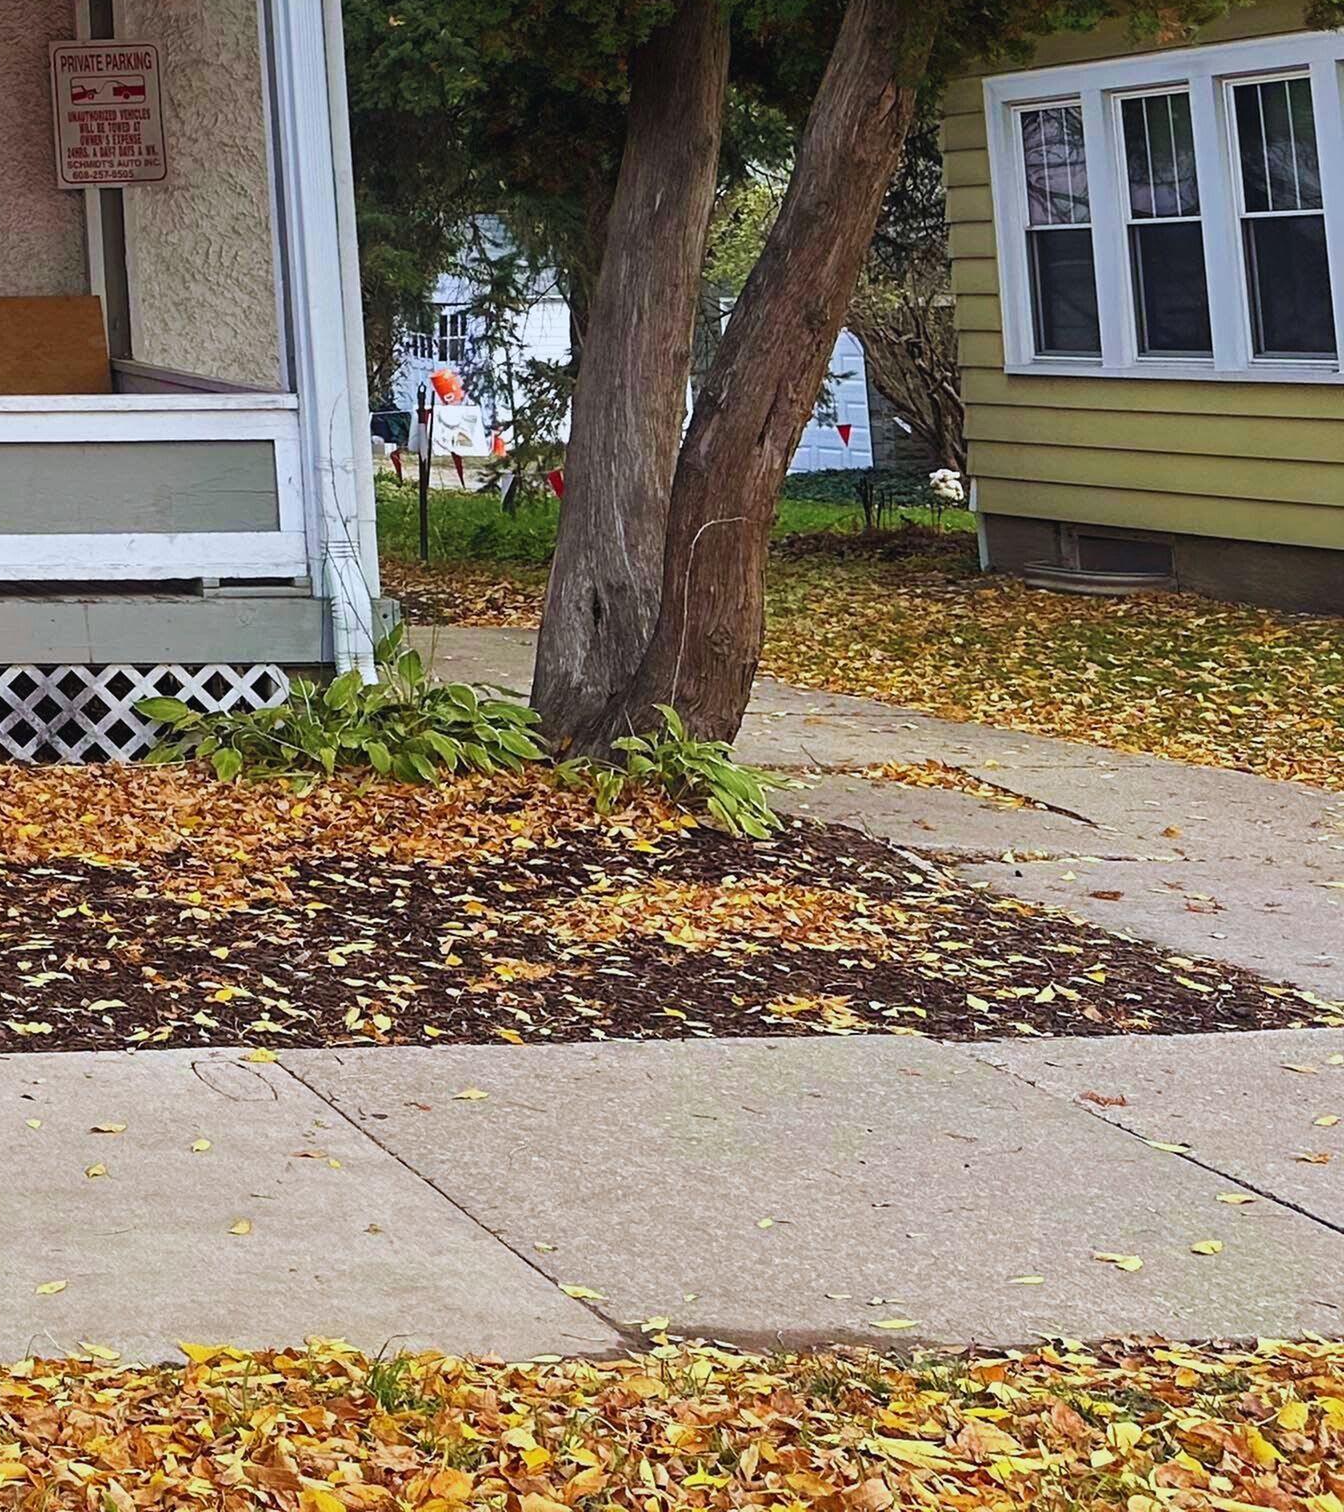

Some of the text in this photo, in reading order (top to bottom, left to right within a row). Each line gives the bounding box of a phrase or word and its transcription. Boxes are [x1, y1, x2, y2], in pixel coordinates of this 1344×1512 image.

[60, 52, 152, 72] PRIVATE PARKING
[68, 108, 151, 122] UNAUTHORIZED VEHICLES
[79, 121, 141, 133] WILL BE TOWED AT
[112, 133, 142, 145] EXPENSE
[119, 145, 136, 157] DAYS
[117, 158, 142, 168] AUTO
